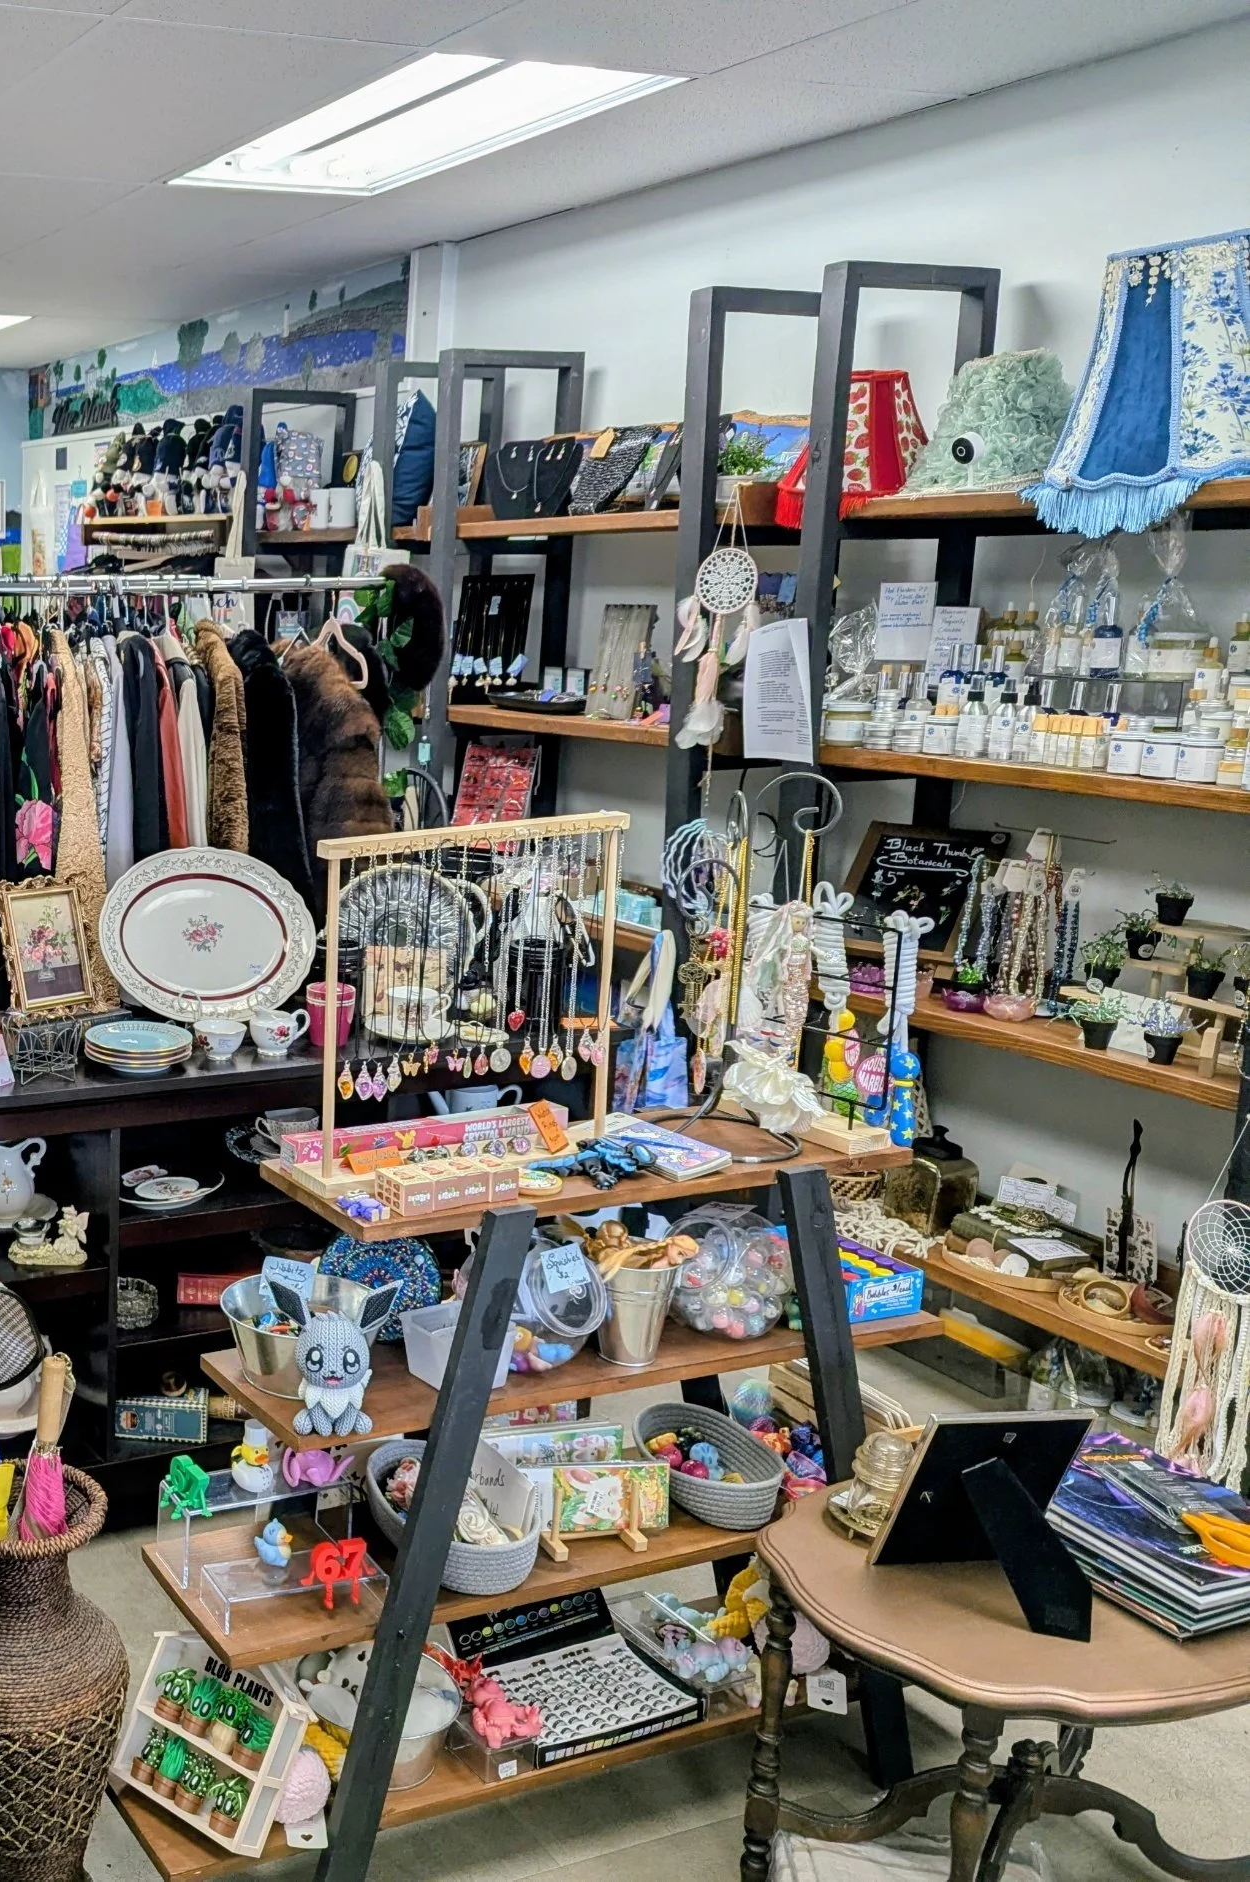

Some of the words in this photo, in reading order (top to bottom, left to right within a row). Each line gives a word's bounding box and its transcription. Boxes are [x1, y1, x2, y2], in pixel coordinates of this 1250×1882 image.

[884, 838, 925, 853] Black
[932, 842, 968, 858] Thumb
[889, 852, 952, 868] Botanicals
[463, 1129, 499, 1142] CRYSTAL
[502, 1125, 530, 1137] WAND
[465, 1120, 497, 1133] WORLD'S
[499, 1117, 530, 1129] LARGEST
[866, 1287, 890, 1300] Bubbles
[312, 1537, 367, 1584] 67
[205, 1656, 232, 1683] BLOB
[233, 1672, 274, 1707] PLANTS
